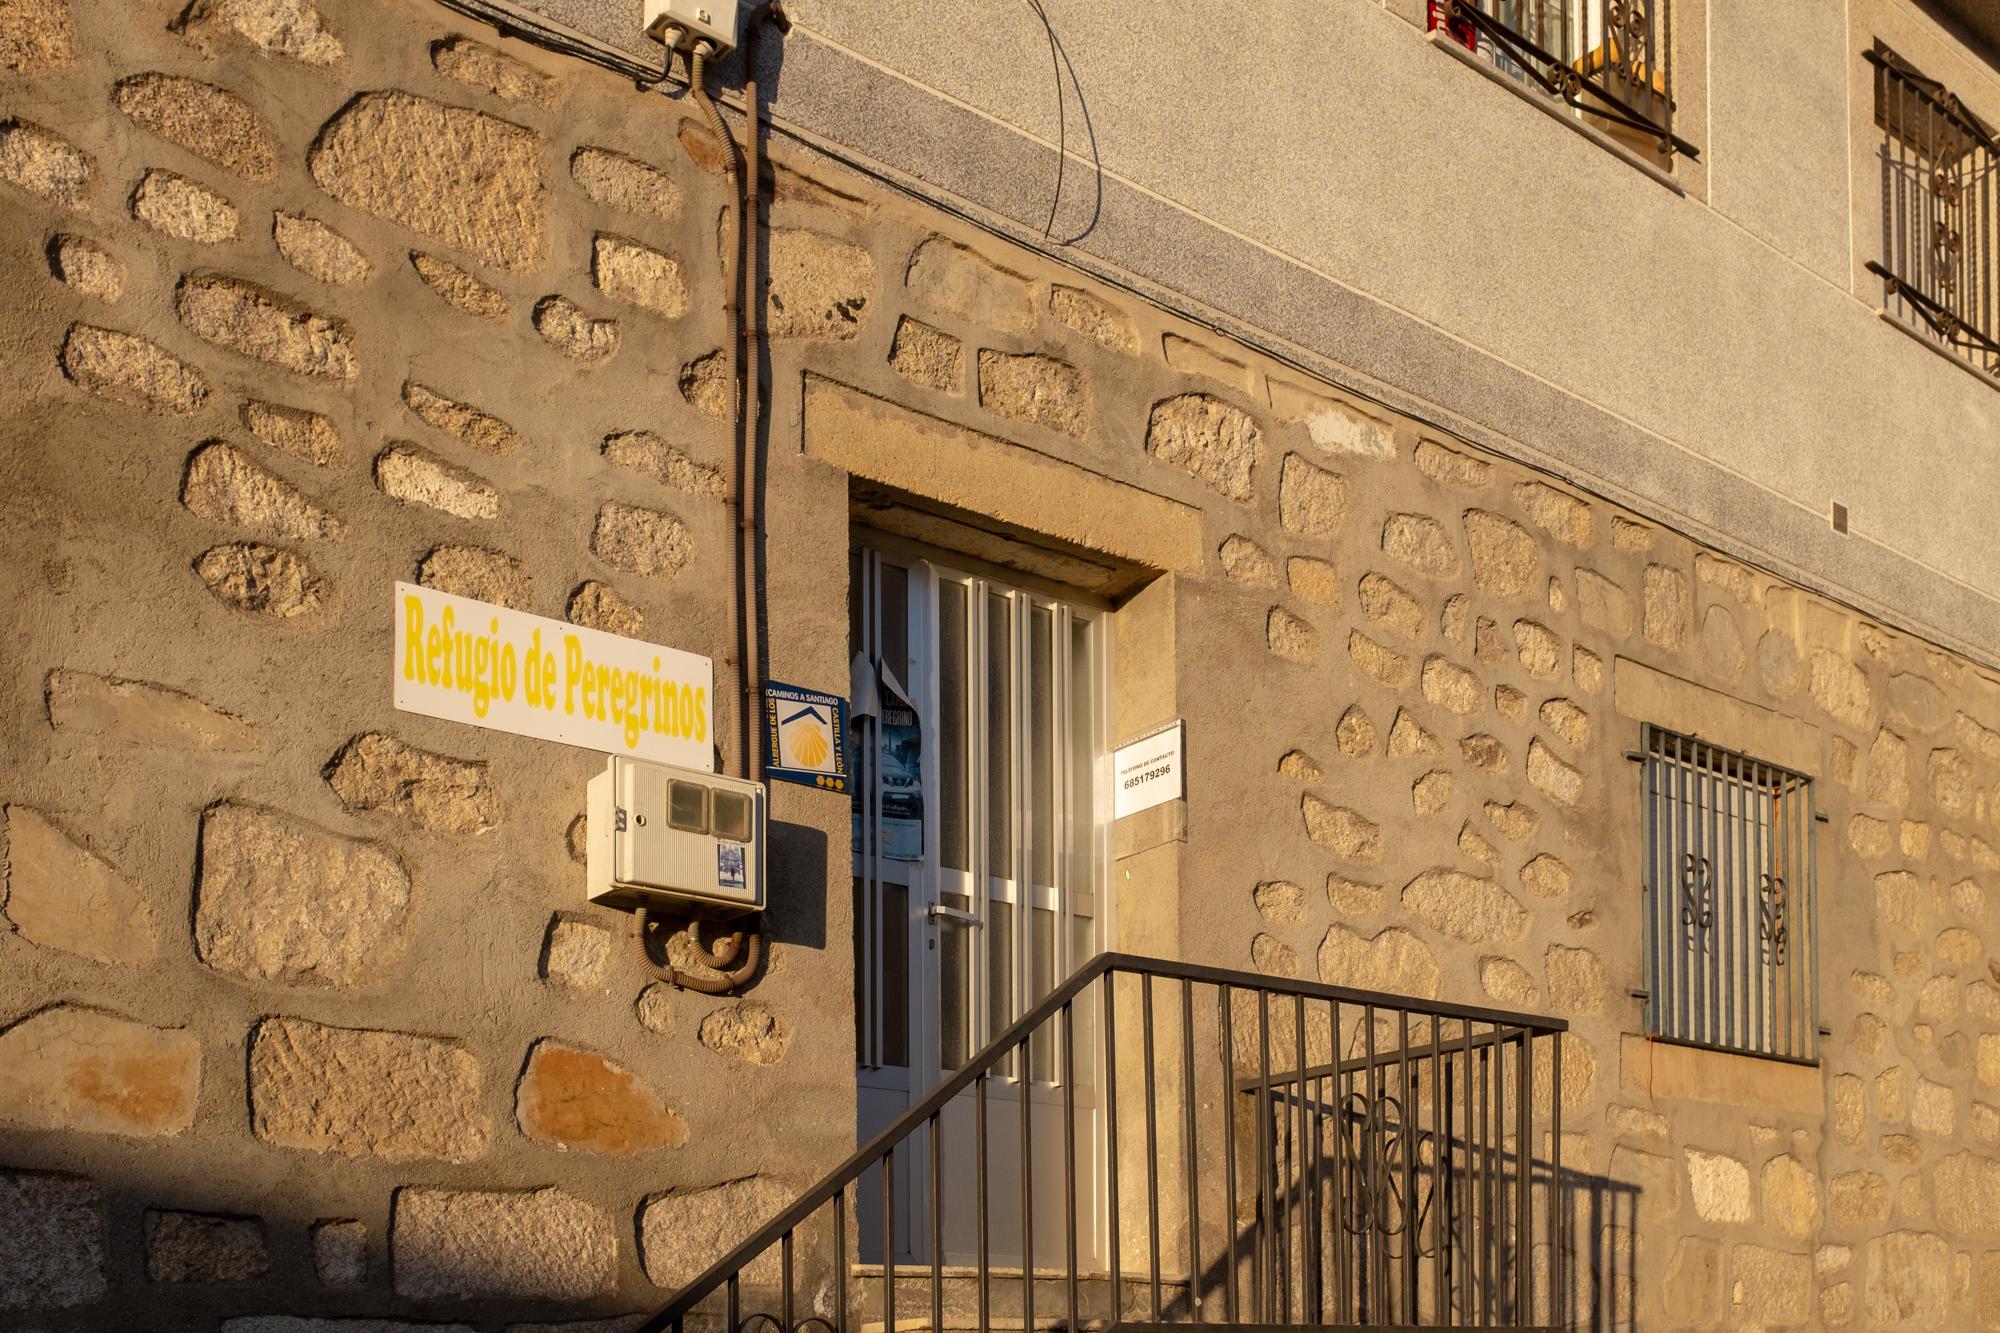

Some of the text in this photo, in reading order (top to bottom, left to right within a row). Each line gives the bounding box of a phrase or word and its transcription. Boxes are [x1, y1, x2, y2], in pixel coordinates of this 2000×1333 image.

[403, 594, 707, 749] Refugio de Peregrinos
[768, 688, 838, 705] CAMINOS A SANTIAGO
[881, 709, 913, 726] EREGRINO
[768, 698, 779, 767] ALBERGUE DE LOS
[832, 707, 840, 744] CASTILLA
[836, 753, 844, 774] LEÓN
[1150, 750, 1175, 764] CONTACTO
[1124, 764, 1171, 790] 685179296
